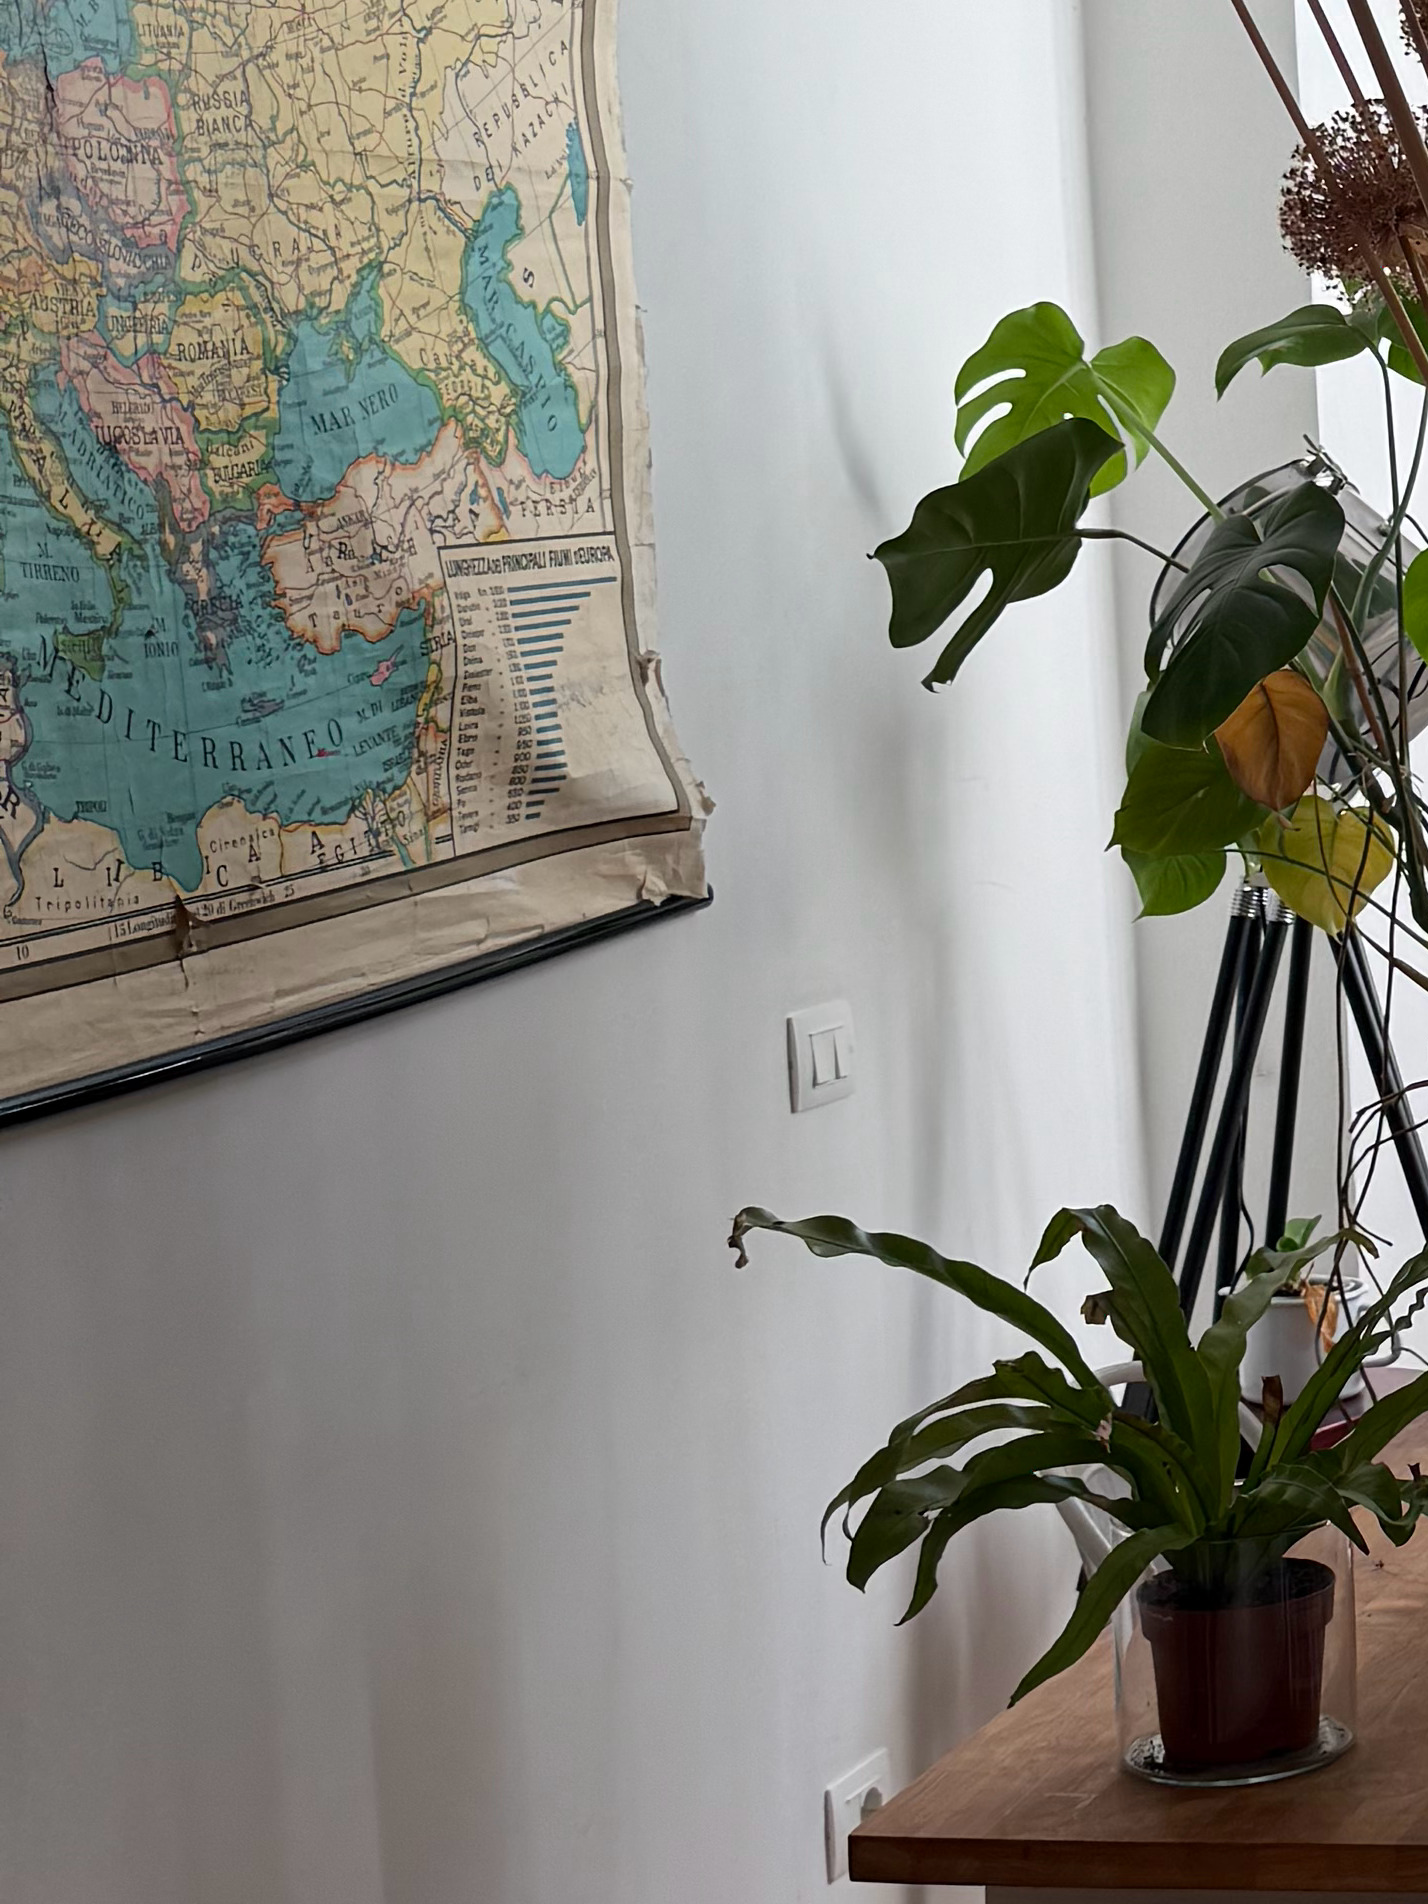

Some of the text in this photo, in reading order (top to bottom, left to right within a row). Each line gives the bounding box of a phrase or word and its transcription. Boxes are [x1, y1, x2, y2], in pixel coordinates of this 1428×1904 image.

[192, 90, 250, 112] RUSSIA
[195, 115, 253, 137] BIANCA
[177, 339, 251, 363] ROMANIA
[310, 382, 400, 437] MAR NERO
[20, 562, 81, 584] TIRRENO
[37, 634, 344, 772] MEDITERRANEO
[16, 945, 30, 961] 10
